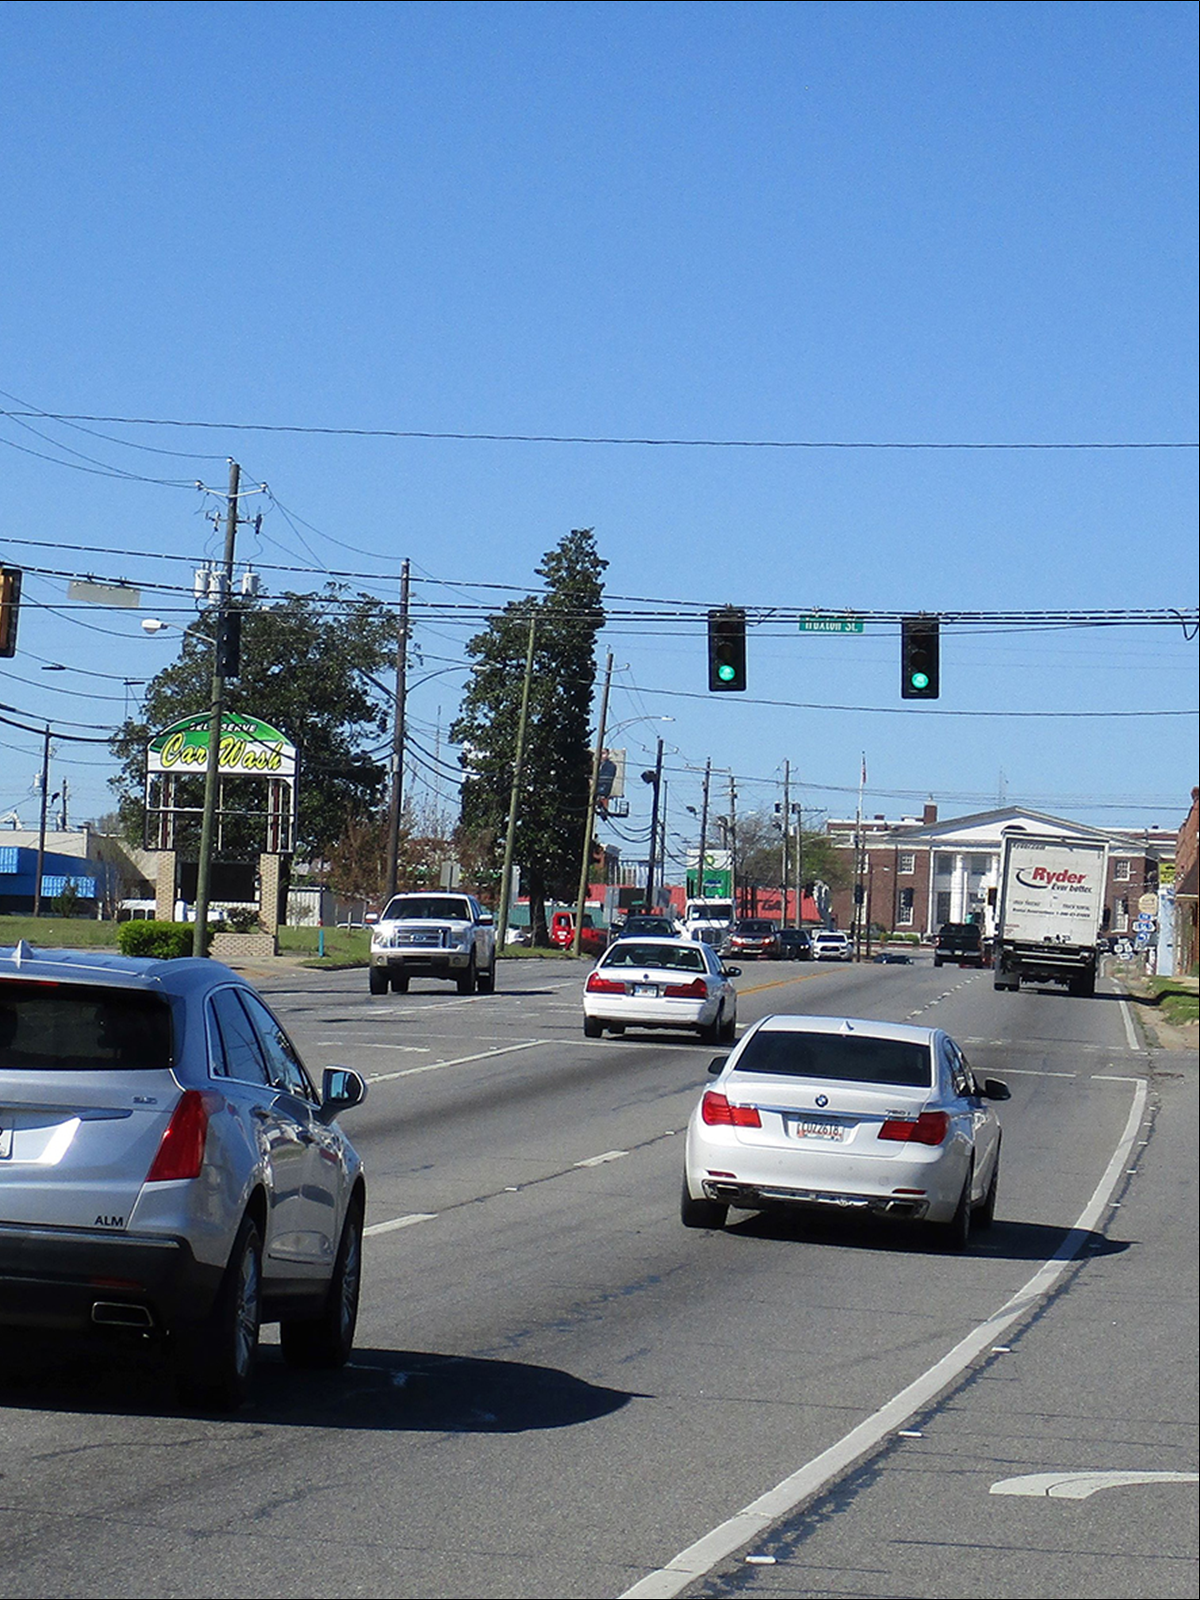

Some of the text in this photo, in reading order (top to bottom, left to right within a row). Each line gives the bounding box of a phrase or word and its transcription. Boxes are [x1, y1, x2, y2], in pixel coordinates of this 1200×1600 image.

[161, 731, 285, 770] Car Wash
[1032, 867, 1087, 884] Ryder
[94, 1215, 123, 1227] ALM
